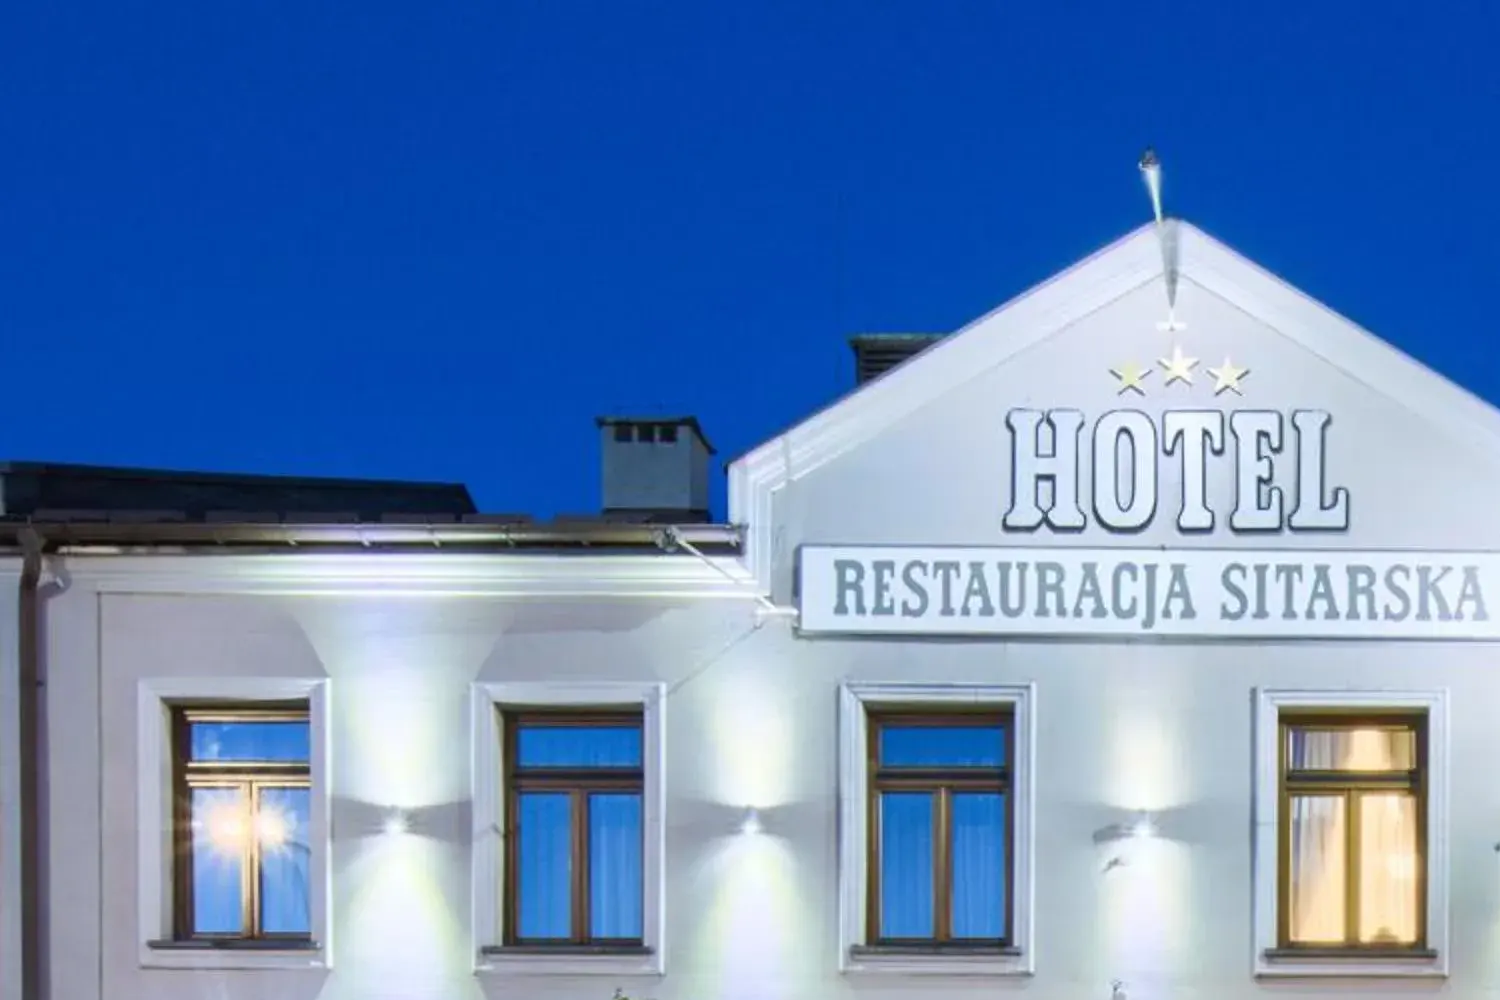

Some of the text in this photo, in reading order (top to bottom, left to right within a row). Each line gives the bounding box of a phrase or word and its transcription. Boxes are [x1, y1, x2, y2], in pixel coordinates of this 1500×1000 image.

[1002, 408, 1350, 533] HOTEL
[834, 559, 1490, 629] RESTAURACJA SITARSKA
